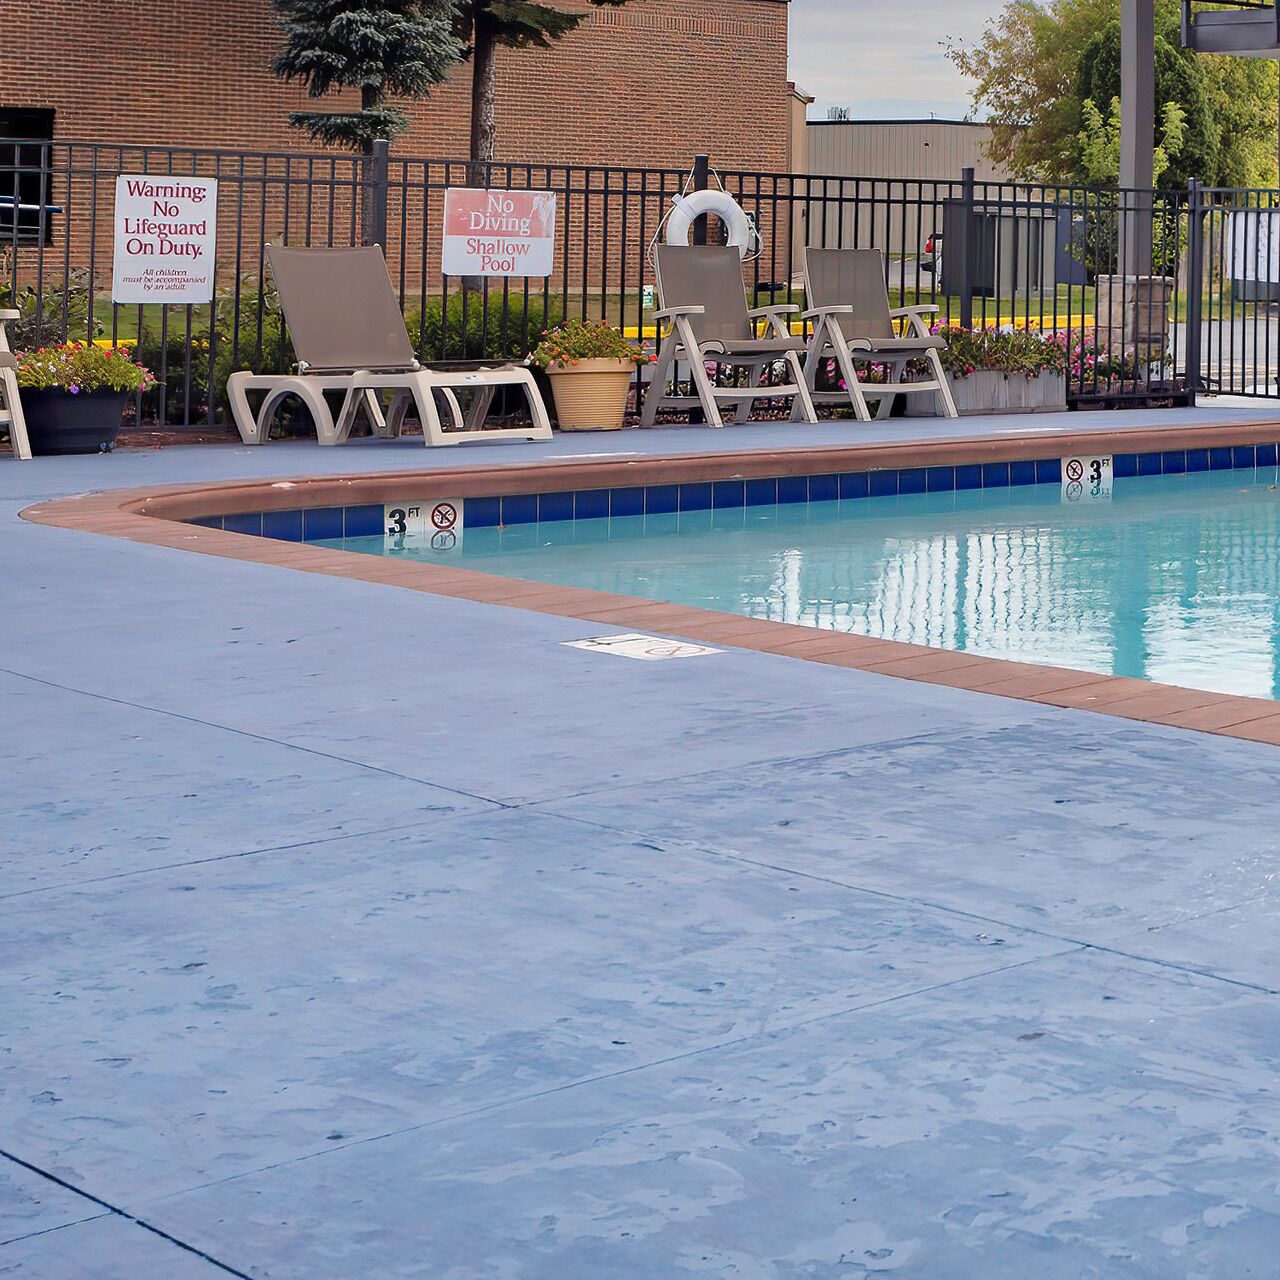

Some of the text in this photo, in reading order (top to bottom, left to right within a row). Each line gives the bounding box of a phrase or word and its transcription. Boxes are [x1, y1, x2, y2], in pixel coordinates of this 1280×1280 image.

[126, 180, 207, 203] Warning:
[153, 201, 180, 217] No
[489, 195, 514, 213] No
[124, 218, 207, 238] Lifeguard
[470, 211, 531, 235] Diving
[126, 238, 203, 259] On Duty.
[466, 238, 531, 256] Shallow
[481, 256, 515, 272] Pool
[1090, 458, 1111, 483] 3 FT
[388, 506, 420, 536] 3 FT
